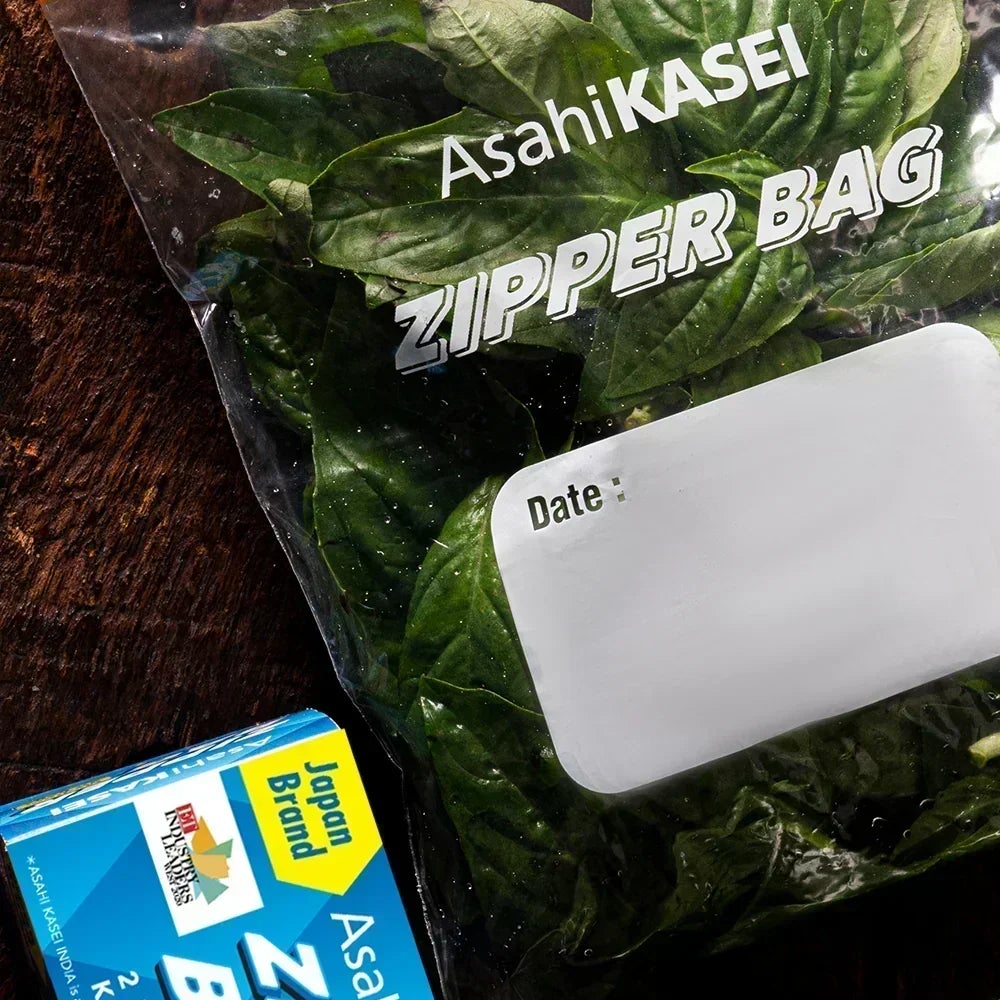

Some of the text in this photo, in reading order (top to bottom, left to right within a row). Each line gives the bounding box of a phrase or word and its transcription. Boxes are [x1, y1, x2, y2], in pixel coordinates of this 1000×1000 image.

[441, 23, 810, 199] AsahiKASEI
[394, 124, 943, 375] ZIPPER BAG
[526, 481, 603, 531] Date
[177, 806, 199, 831] ET
[267, 772, 328, 860] Brand
[304, 762, 353, 847] Japan
[161, 833, 194, 904] LEADERS
[164, 809, 200, 883] INDUSTRY
[164, 862, 176, 885] WEST
[42, 906, 64, 944] KASEI
[56, 946, 77, 985] INDIA
[69, 984, 80, 997] is
[118, 971, 139, 989] 2
